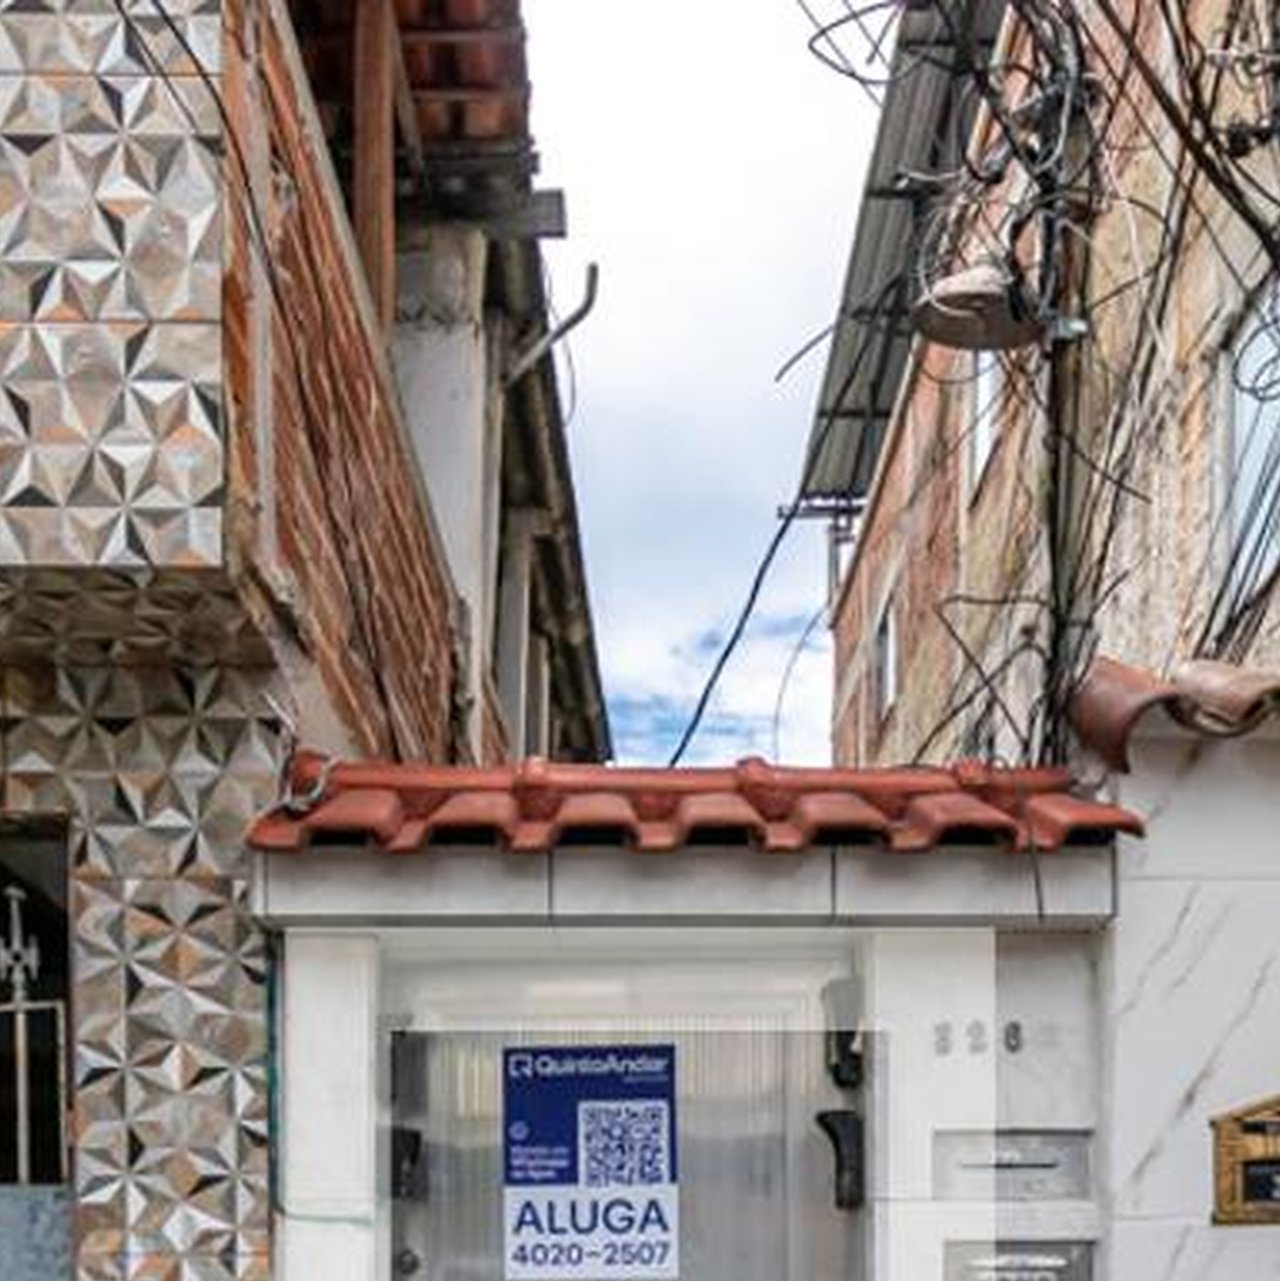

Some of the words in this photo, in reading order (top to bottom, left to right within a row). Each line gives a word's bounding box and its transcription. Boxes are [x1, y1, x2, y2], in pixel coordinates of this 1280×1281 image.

[534, 1053, 669, 1077] QuintoAndar
[513, 1200, 669, 1235] ALUGA
[511, 1243, 670, 1266] 4020-2507
